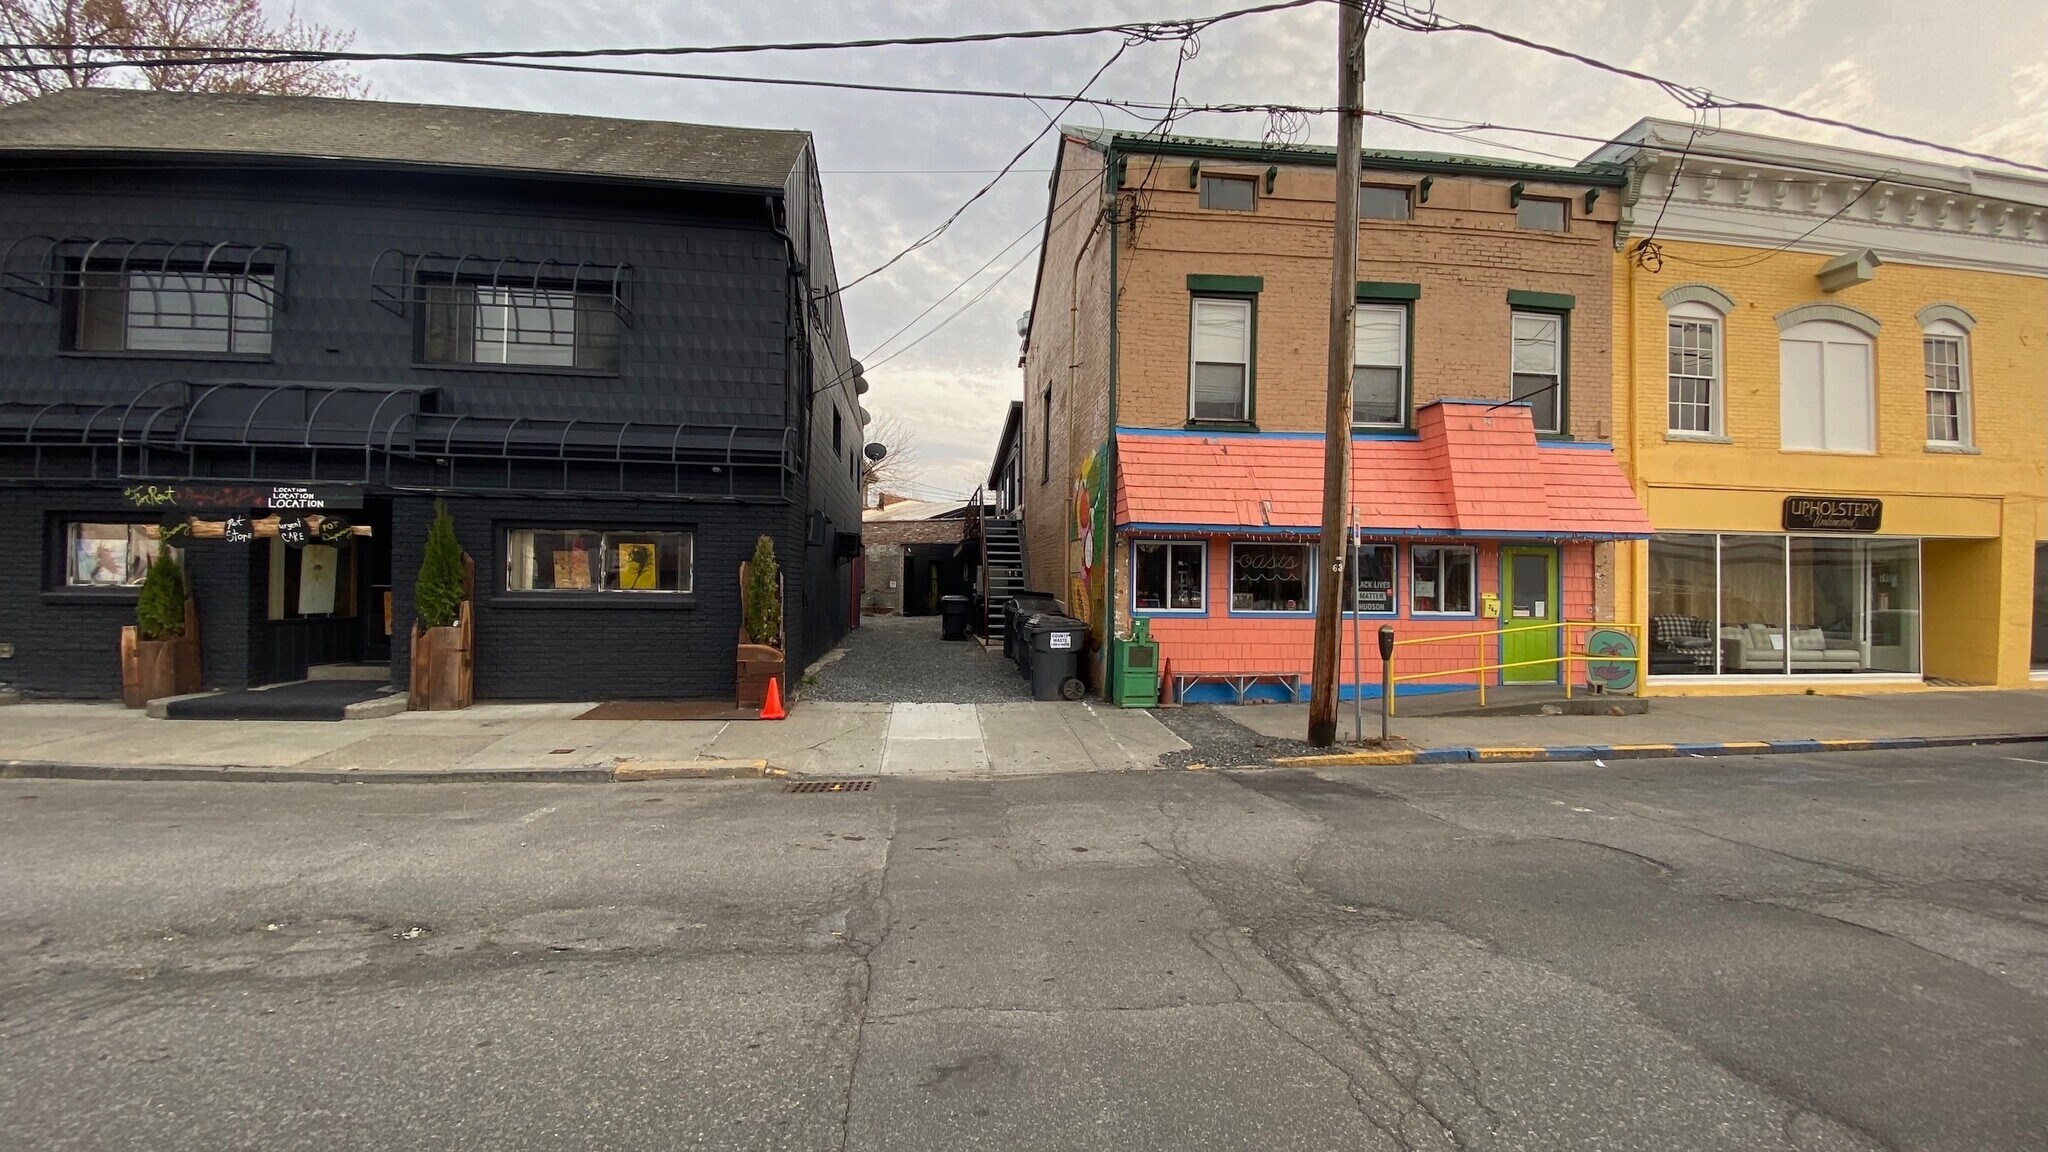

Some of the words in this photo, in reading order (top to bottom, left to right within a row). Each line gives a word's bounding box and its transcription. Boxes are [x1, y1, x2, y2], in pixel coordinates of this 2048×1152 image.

[148, 485, 178, 506] Rent
[268, 498, 324, 508] LOCATION
[1791, 501, 1878, 516] UPHOLSTERY
[281, 531, 305, 543] CARE
[1235, 554, 1299, 569] oasis
[1332, 563, 1344, 573] 63
[1373, 580, 1391, 589] LIVES
[1359, 592, 1384, 600] MATTER
[1359, 603, 1385, 611] HUDSON
